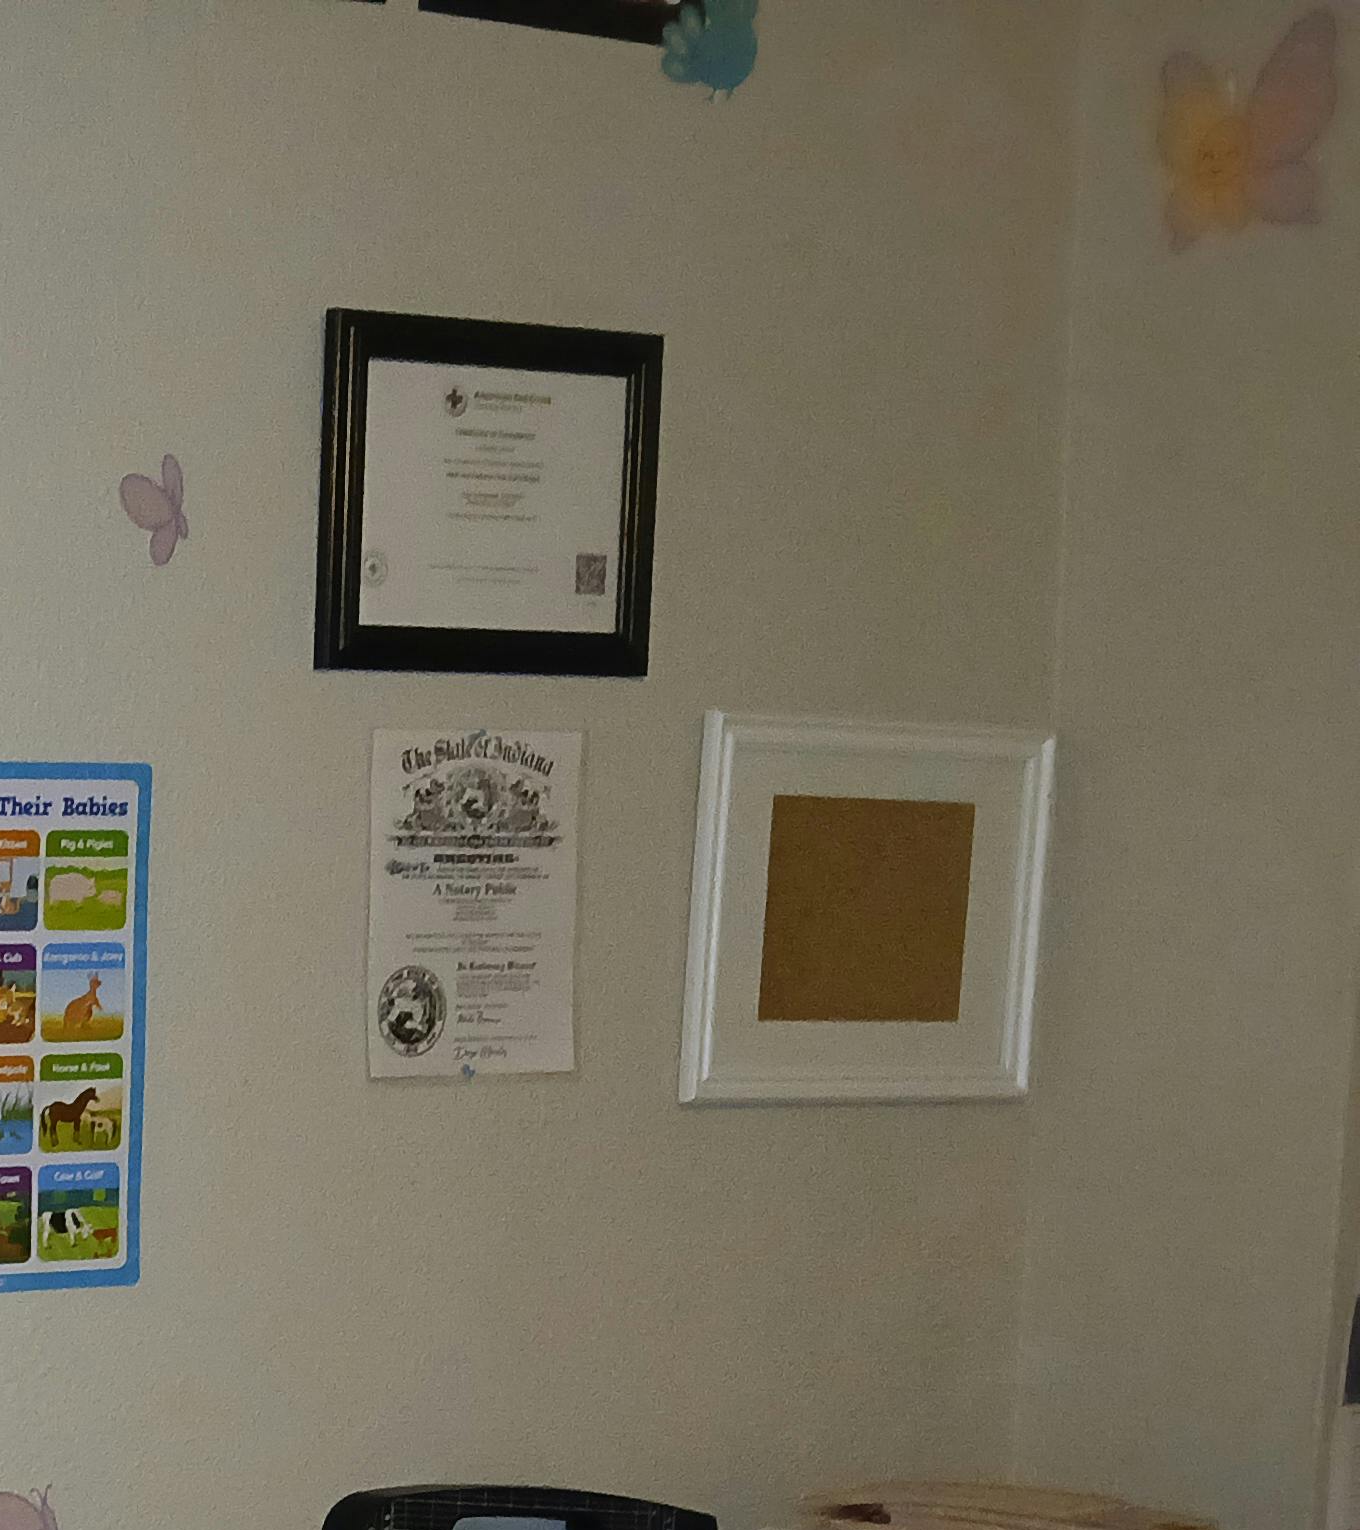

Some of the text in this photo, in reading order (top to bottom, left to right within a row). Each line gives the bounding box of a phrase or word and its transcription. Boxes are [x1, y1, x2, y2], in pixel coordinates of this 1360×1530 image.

[402, 748, 432, 774] The
[61, 797, 128, 817] Babies
[4, 952, 23, 963] Cub
